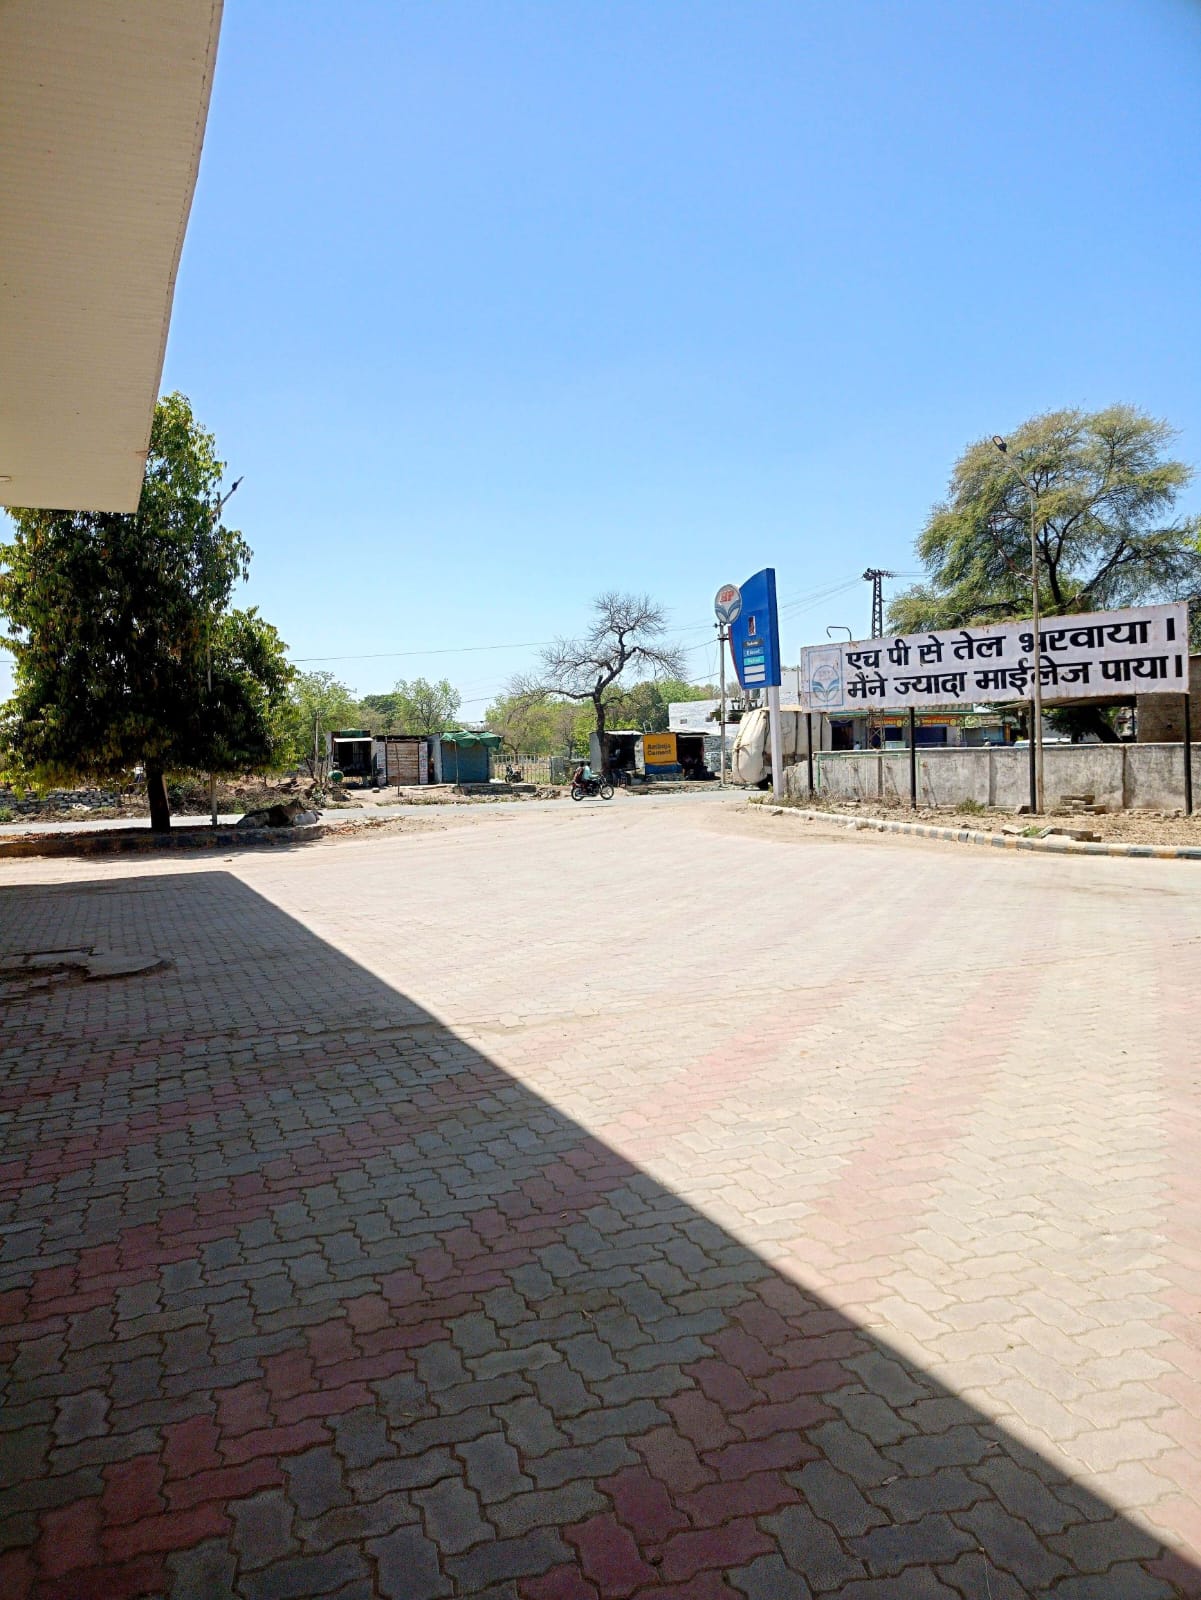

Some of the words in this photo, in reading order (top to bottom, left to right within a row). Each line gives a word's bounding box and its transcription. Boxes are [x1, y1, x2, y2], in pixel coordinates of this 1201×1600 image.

[846, 649, 882, 670] एच
[887, 638, 911, 666] पी
[917, 635, 945, 665] से
[951, 630, 1007, 660] तेल
[847, 671, 888, 699] मैंने
[893, 671, 967, 698] ज्यादा
